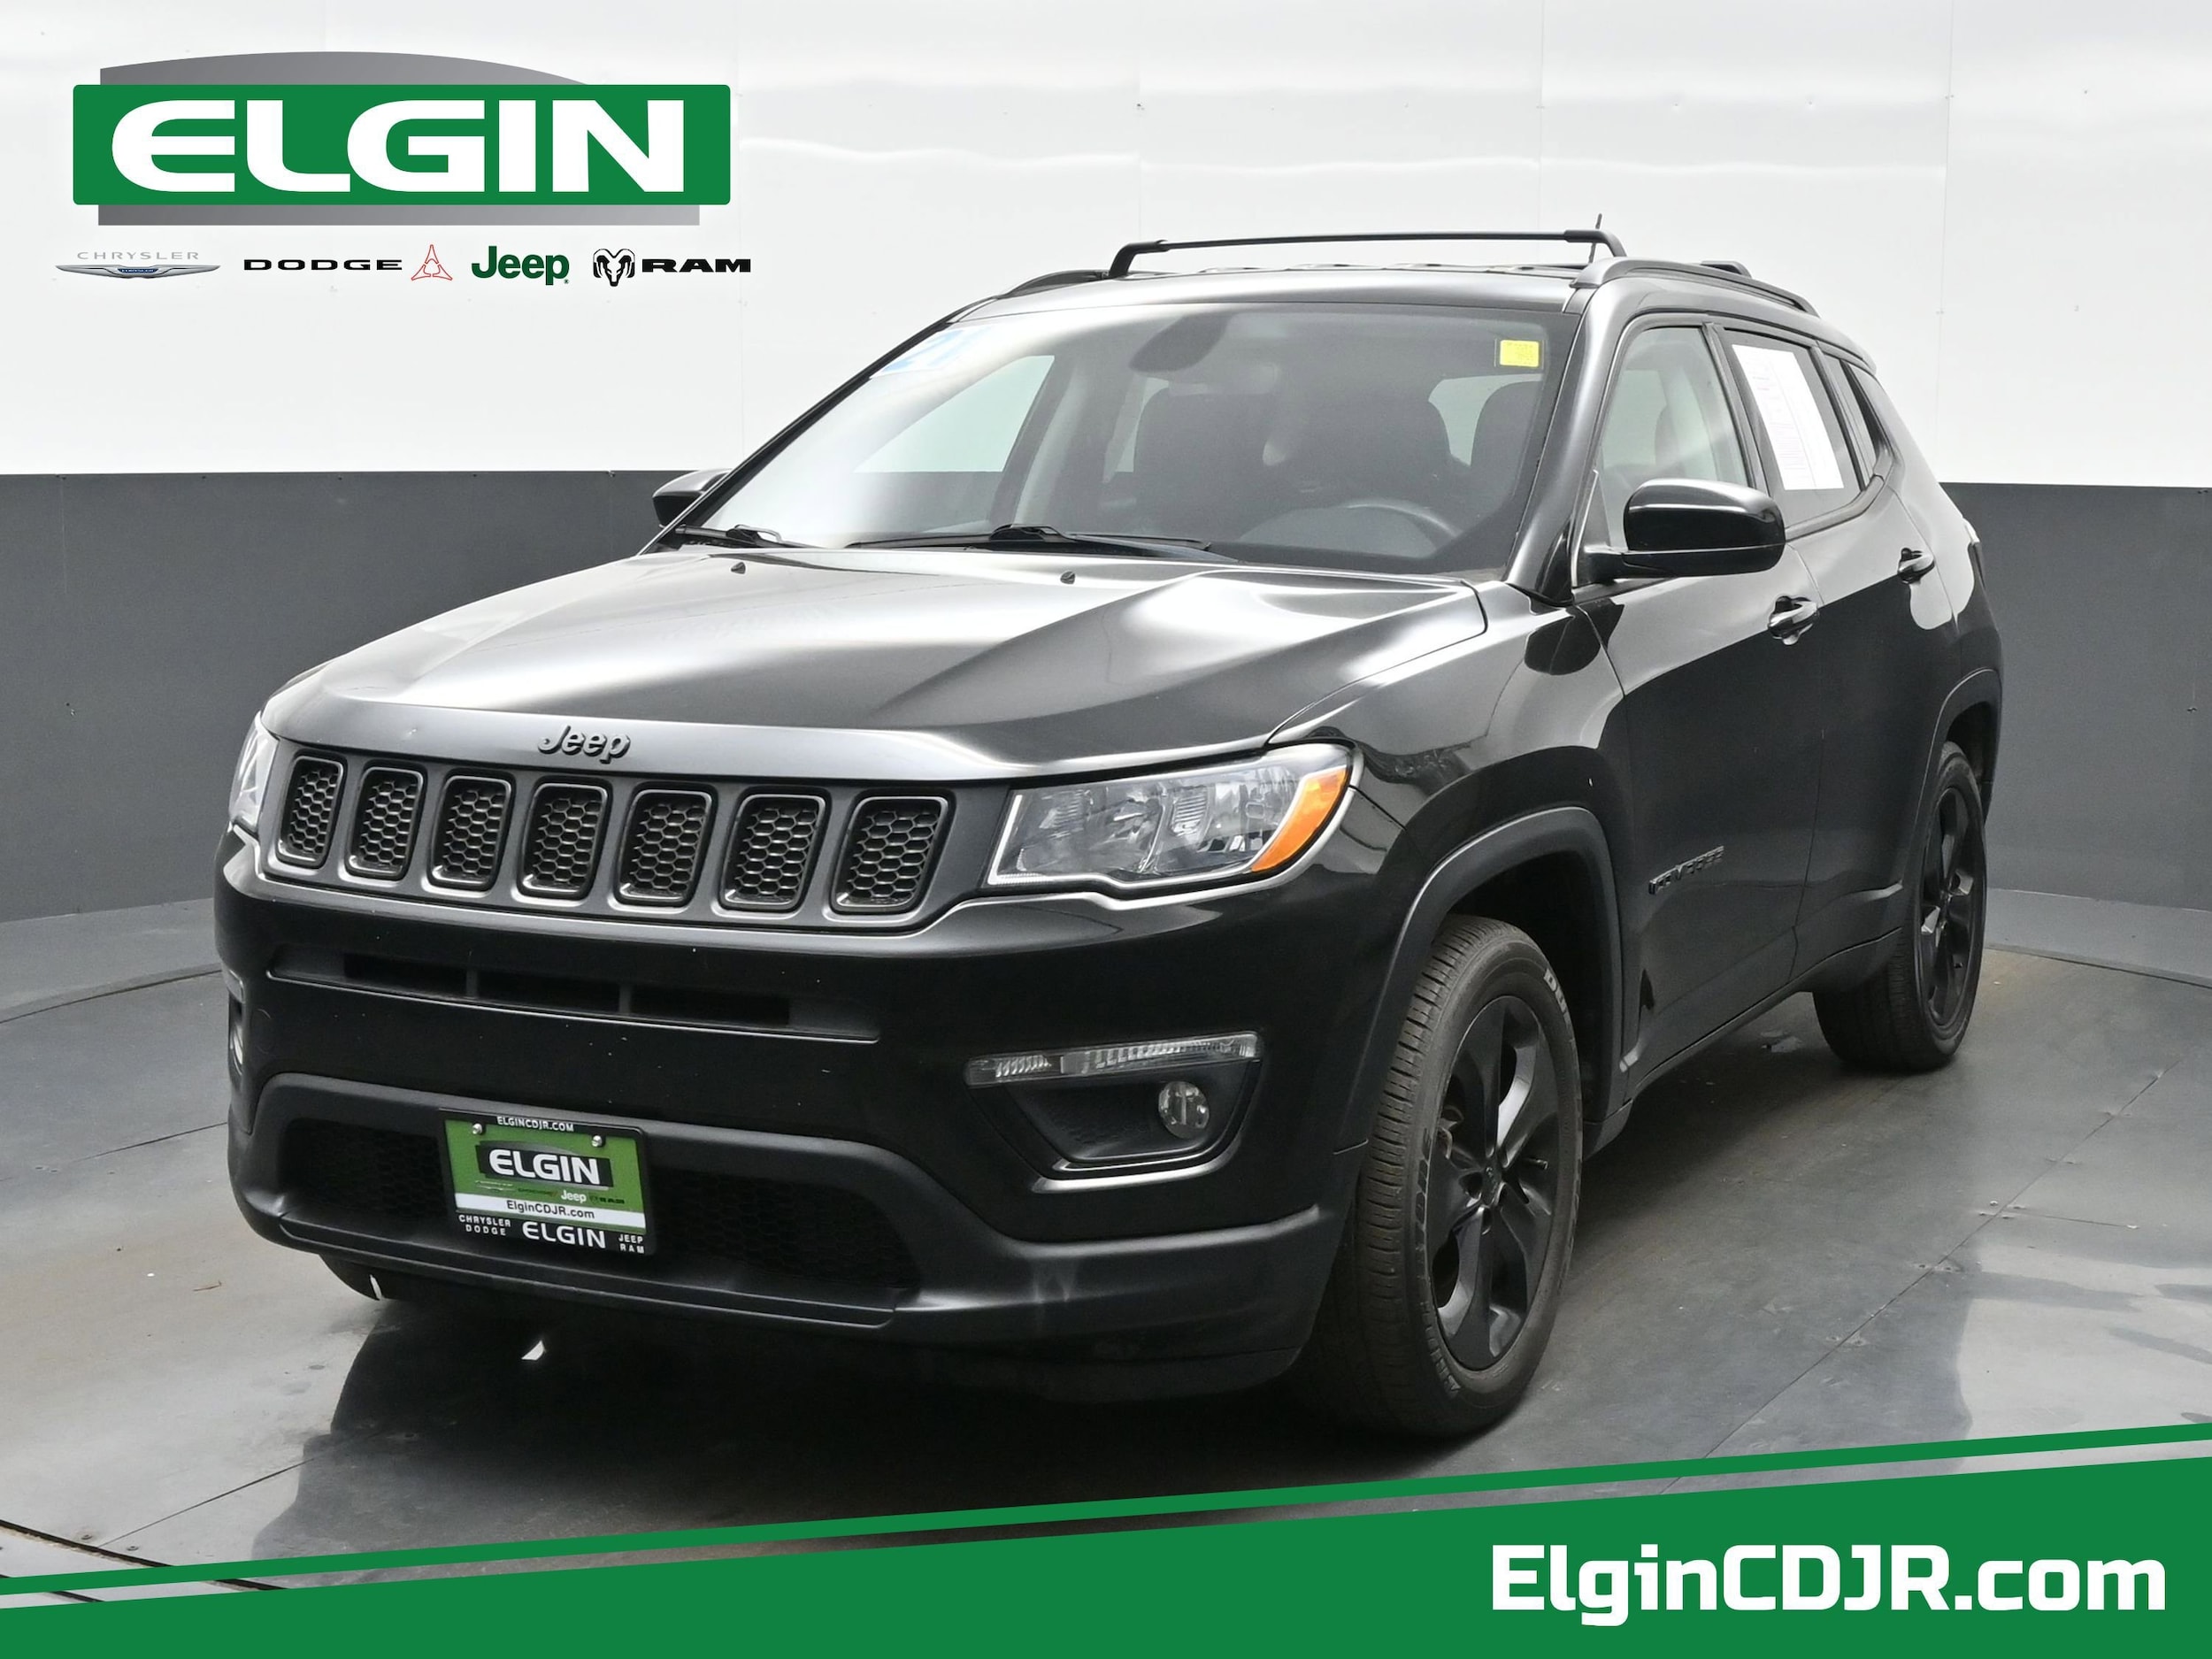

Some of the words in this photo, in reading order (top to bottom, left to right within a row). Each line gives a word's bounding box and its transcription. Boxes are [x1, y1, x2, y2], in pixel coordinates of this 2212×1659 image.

[537, 725, 632, 764] Jeep
[496, 1116, 574, 1133] ELGINCDJR.COM
[488, 1148, 601, 1186] ELGIN
[560, 1189, 588, 1203] Jeep
[506, 1200, 595, 1220] ElginCDJR.com
[458, 1214, 511, 1228] CHRYSLER
[465, 1225, 506, 1236] DODGE
[522, 1221, 607, 1249] ELGIN
[618, 1233, 644, 1244] JEEP
[619, 1244, 645, 1255] RAM
